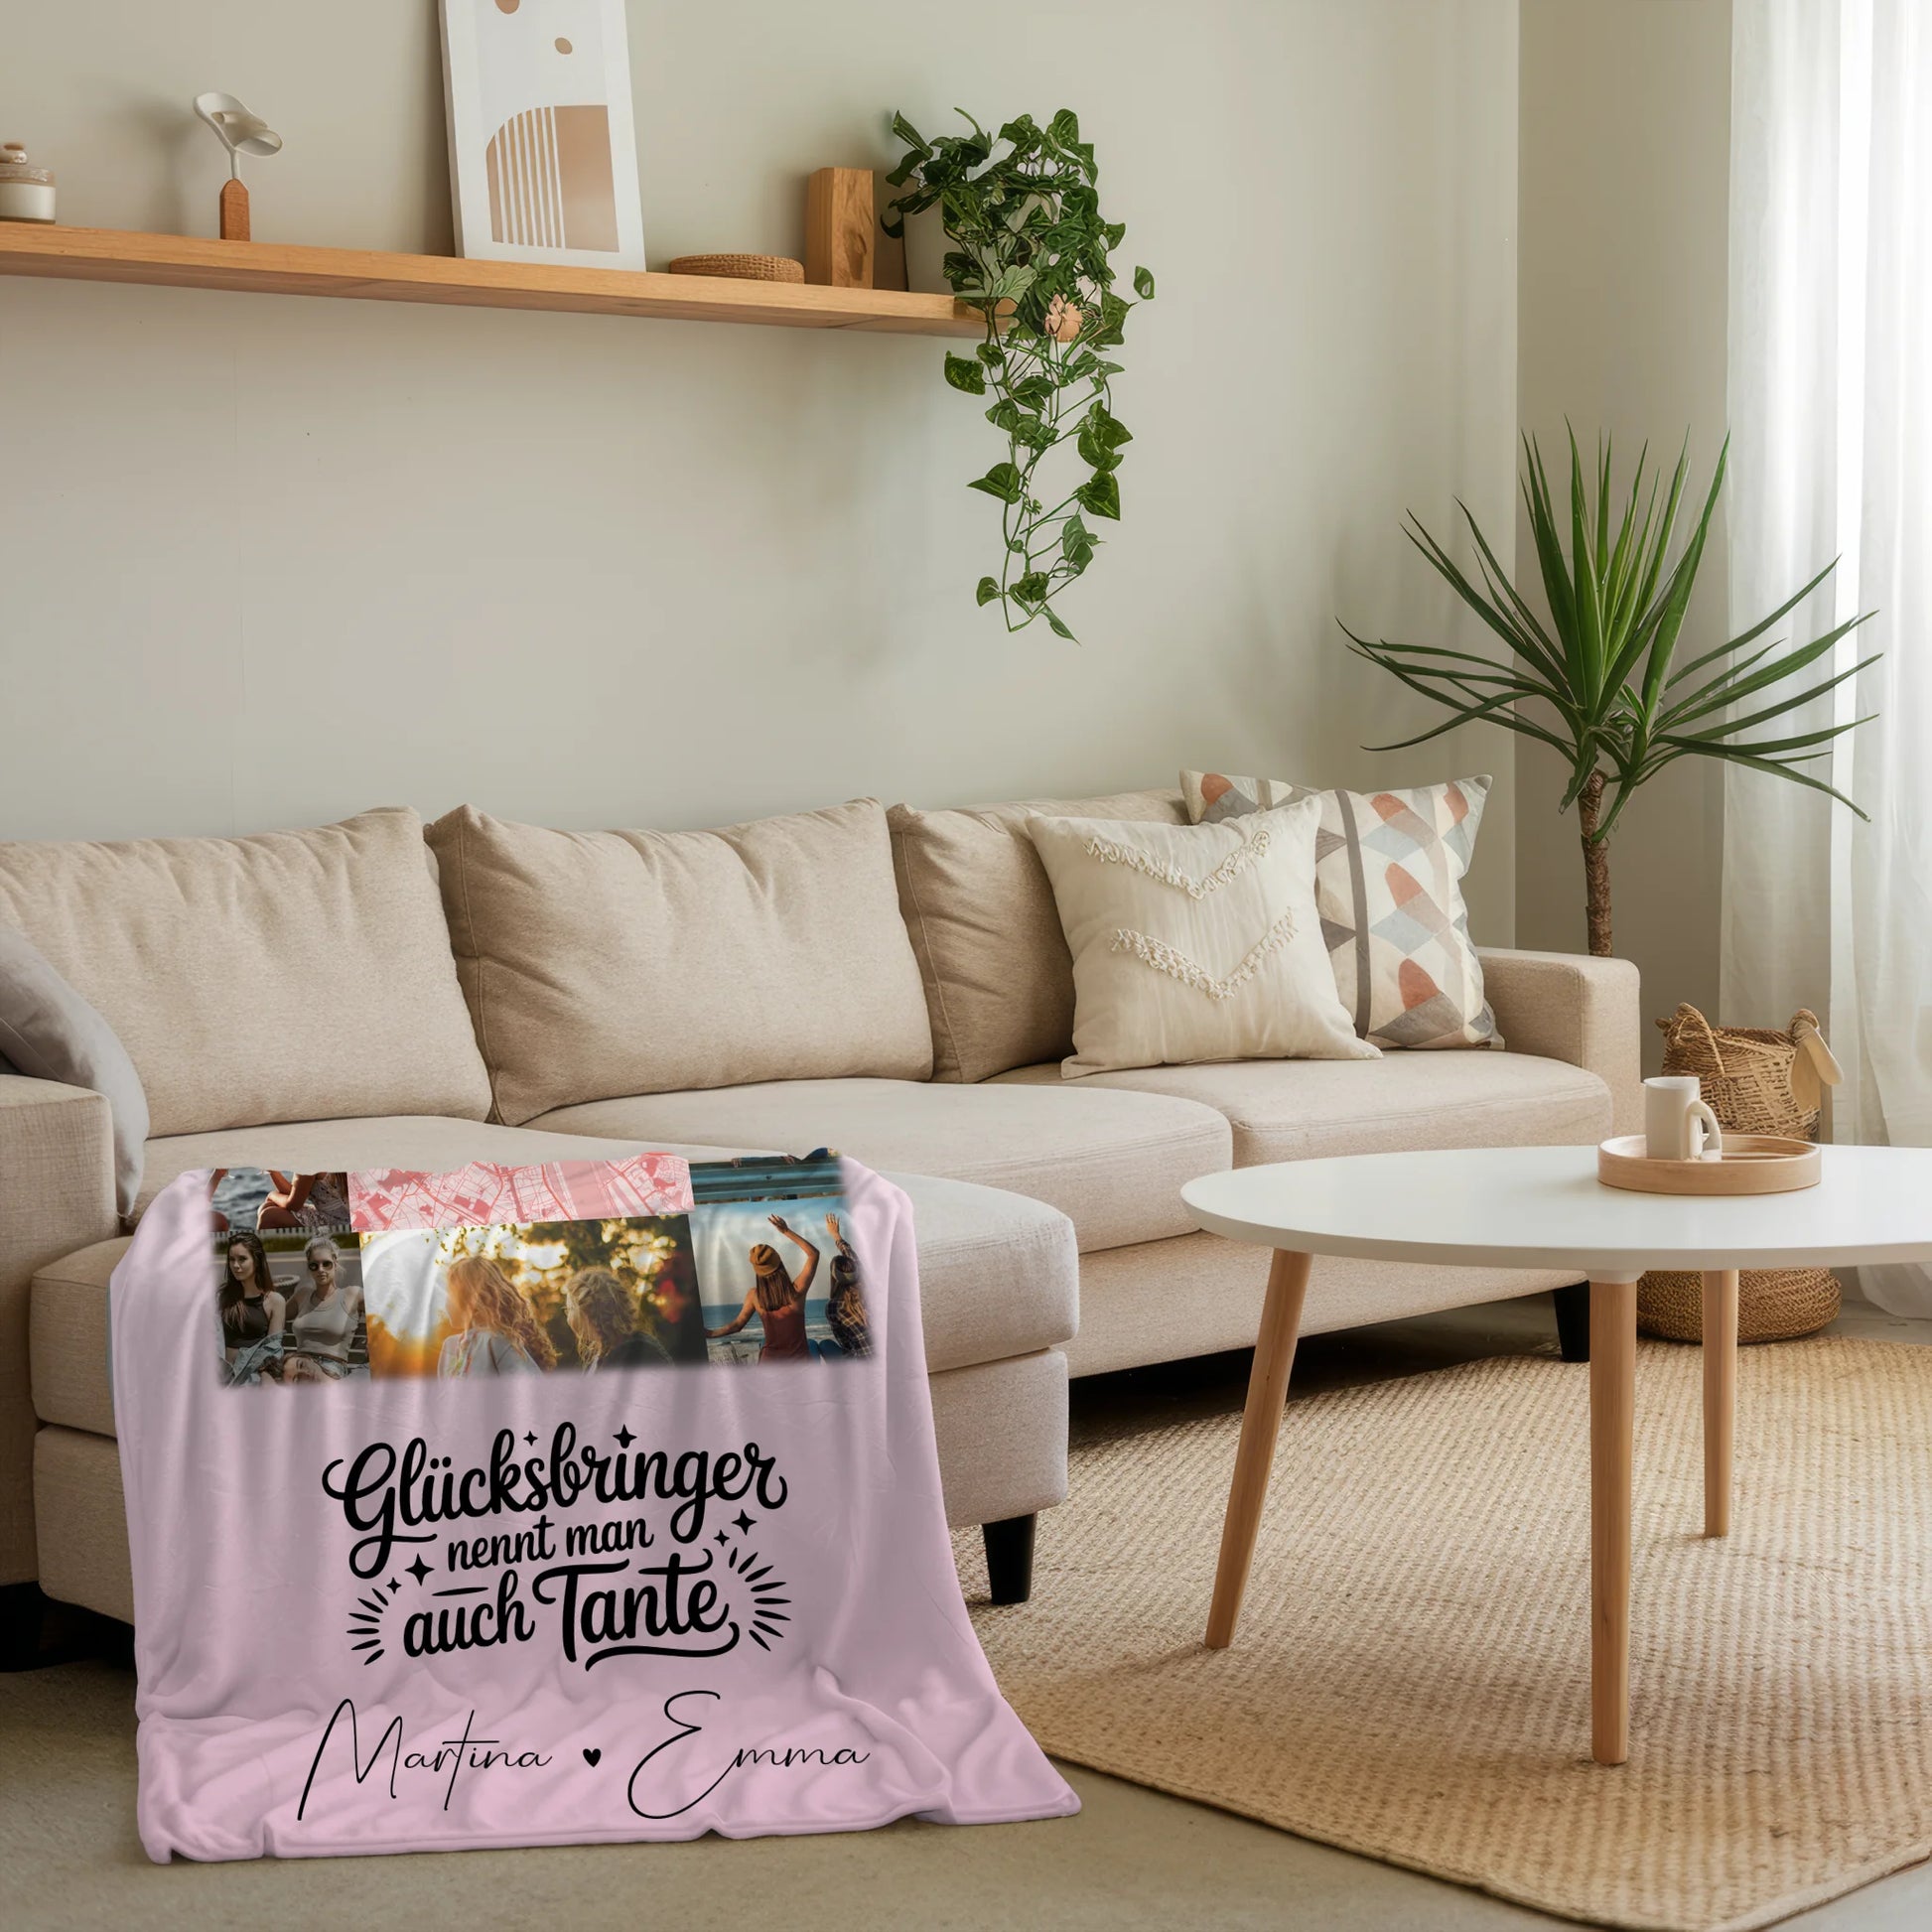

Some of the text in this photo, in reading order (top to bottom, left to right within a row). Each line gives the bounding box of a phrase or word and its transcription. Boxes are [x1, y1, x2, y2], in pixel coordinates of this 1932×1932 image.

[322, 1422, 788, 1580] Glücksbringer
[448, 1515, 655, 1572] nennt man
[403, 1548, 740, 1672] auch Tante
[295, 1690, 871, 1821] Martina Emma
